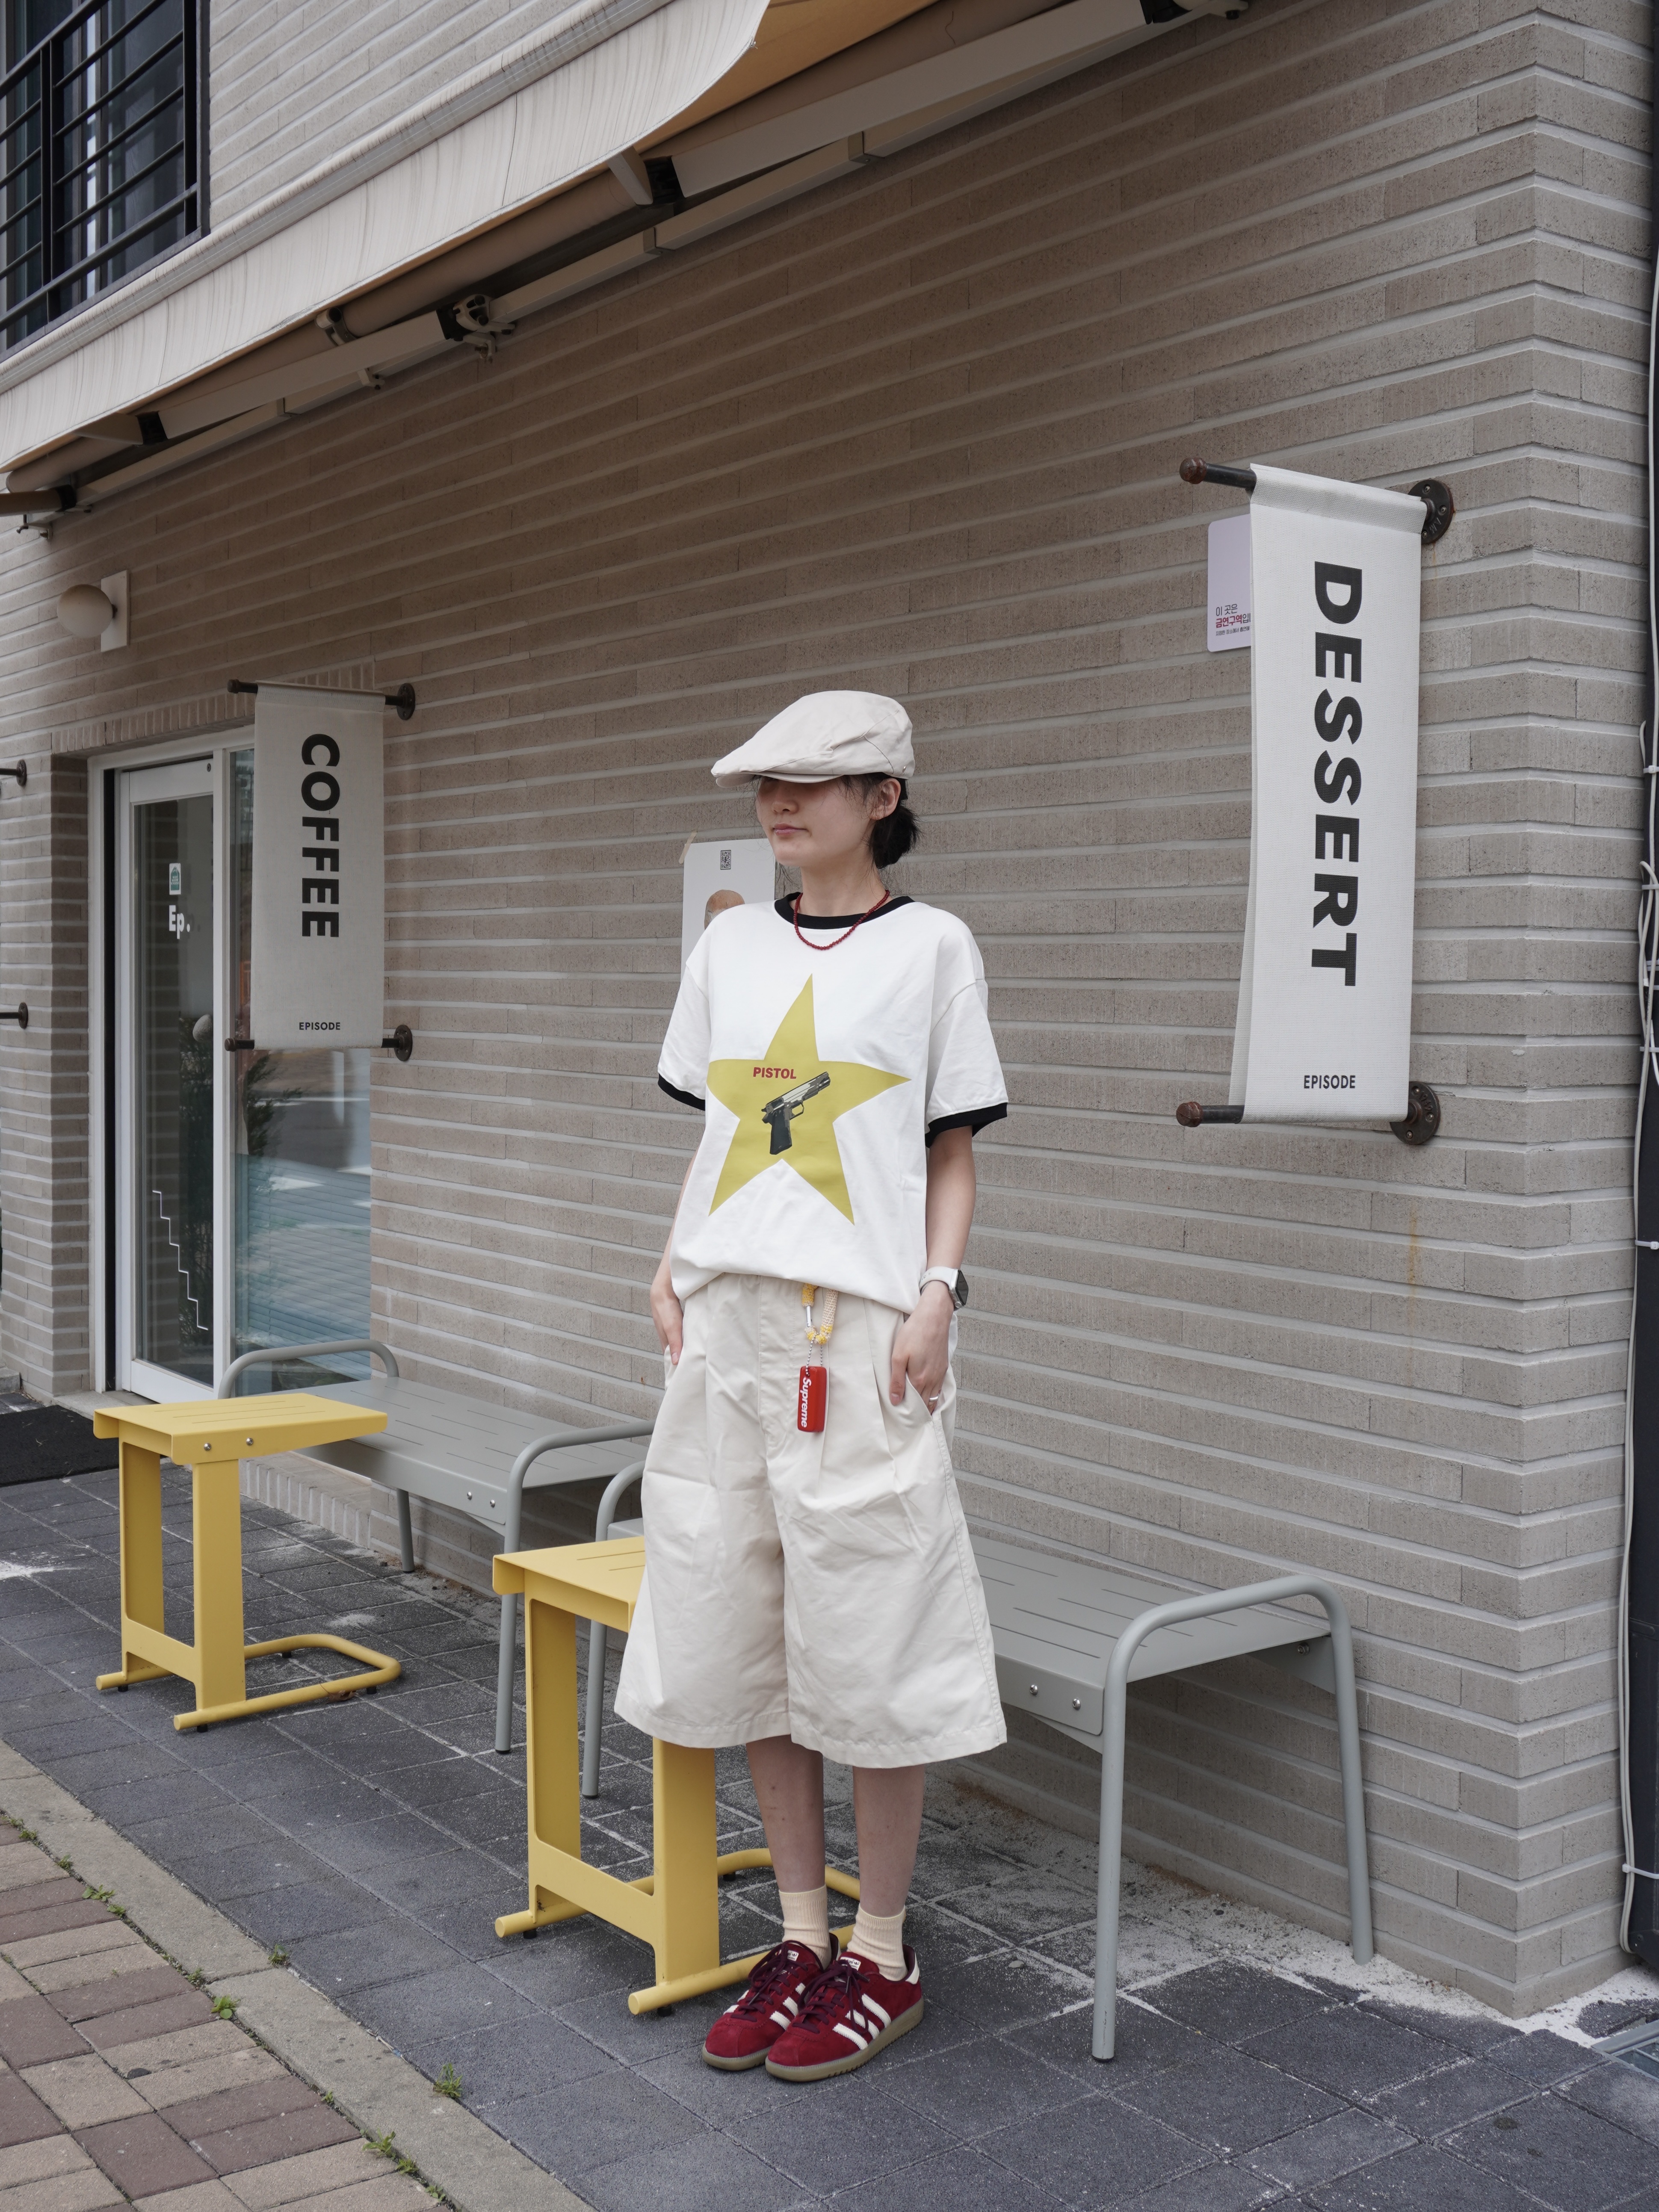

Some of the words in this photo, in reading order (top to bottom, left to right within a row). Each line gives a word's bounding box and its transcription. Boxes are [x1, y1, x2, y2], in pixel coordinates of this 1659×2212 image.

[1216, 606, 1222, 616] 이
[1224, 604, 1238, 615] 곳은
[1215, 613, 1251, 628] 금연구역입
[1311, 561, 1363, 987] DESSERT
[302, 734, 340, 938] COFFEE
[169, 905, 191, 939] Ep.
[299, 1022, 341, 1031] EPISODE
[753, 1066, 797, 1079] PISTOL
[1304, 1075, 1356, 1090] EPISODE
[800, 1377, 812, 1428] Supreme
